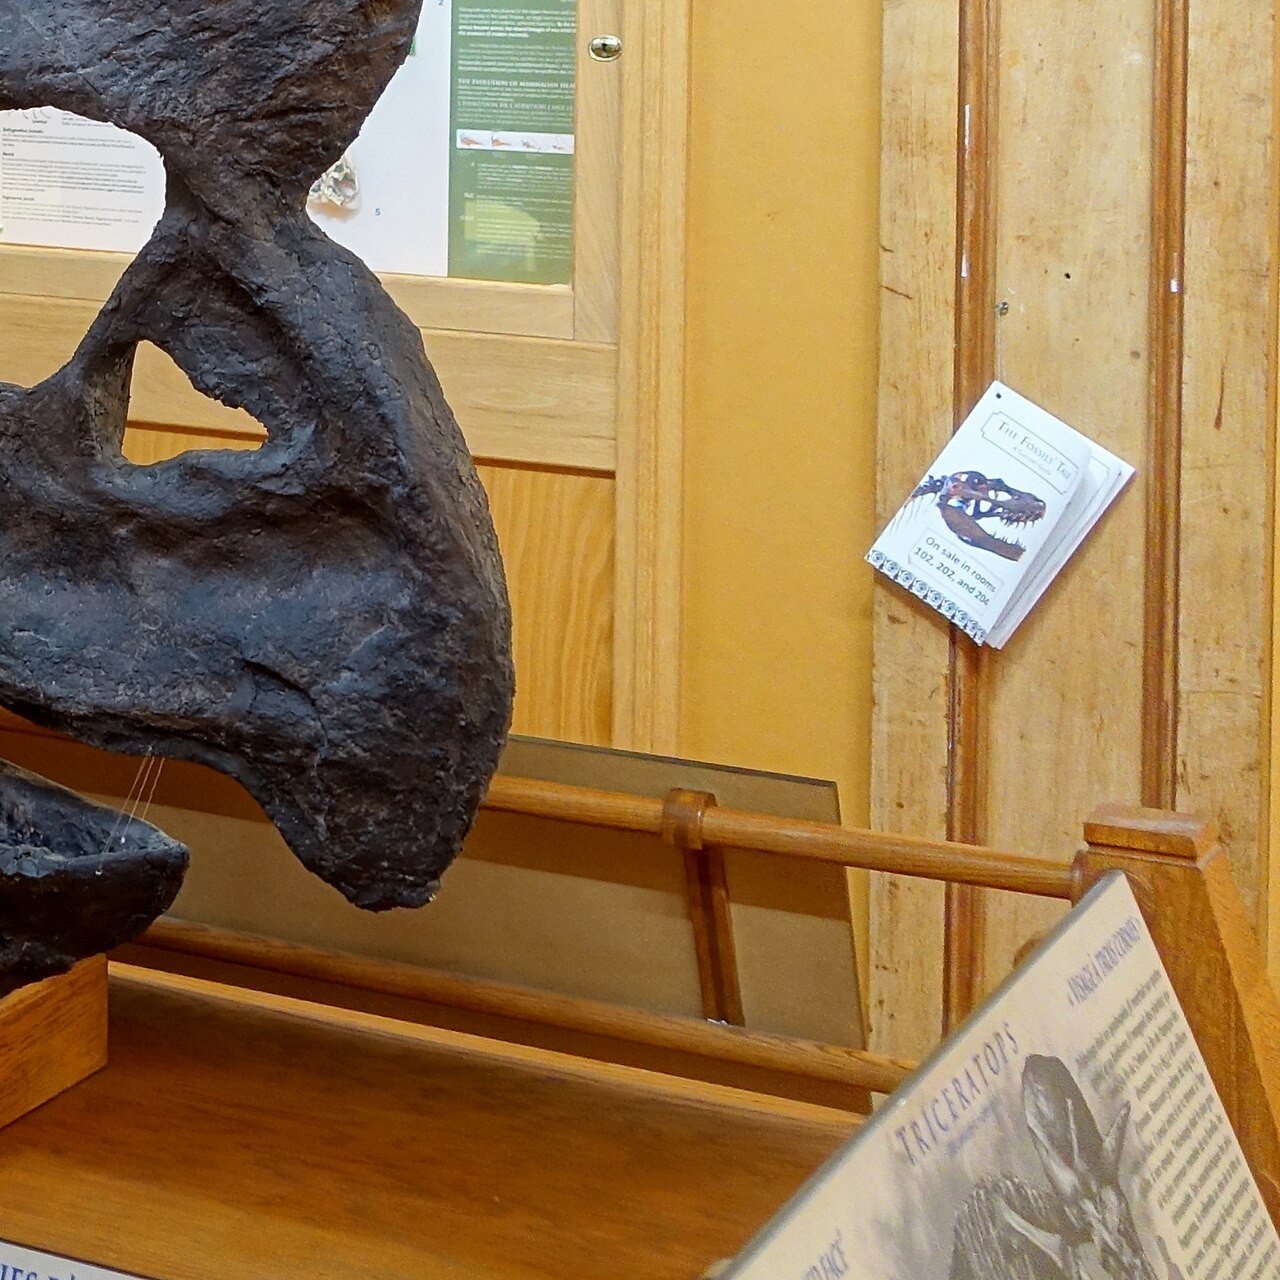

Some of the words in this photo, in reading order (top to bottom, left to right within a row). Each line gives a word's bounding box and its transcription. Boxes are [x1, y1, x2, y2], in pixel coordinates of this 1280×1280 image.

[914, 547, 934, 566] 102,
[936, 562, 955, 582] 202,
[957, 579, 976, 594] and
[974, 590, 990, 606] 204
[925, 537, 940, 551] On
[941, 549, 960, 564] sale
[961, 561, 971, 572] in
[971, 570, 996, 593] rooms
[894, 1022, 1018, 1167] TRICERATOPS
